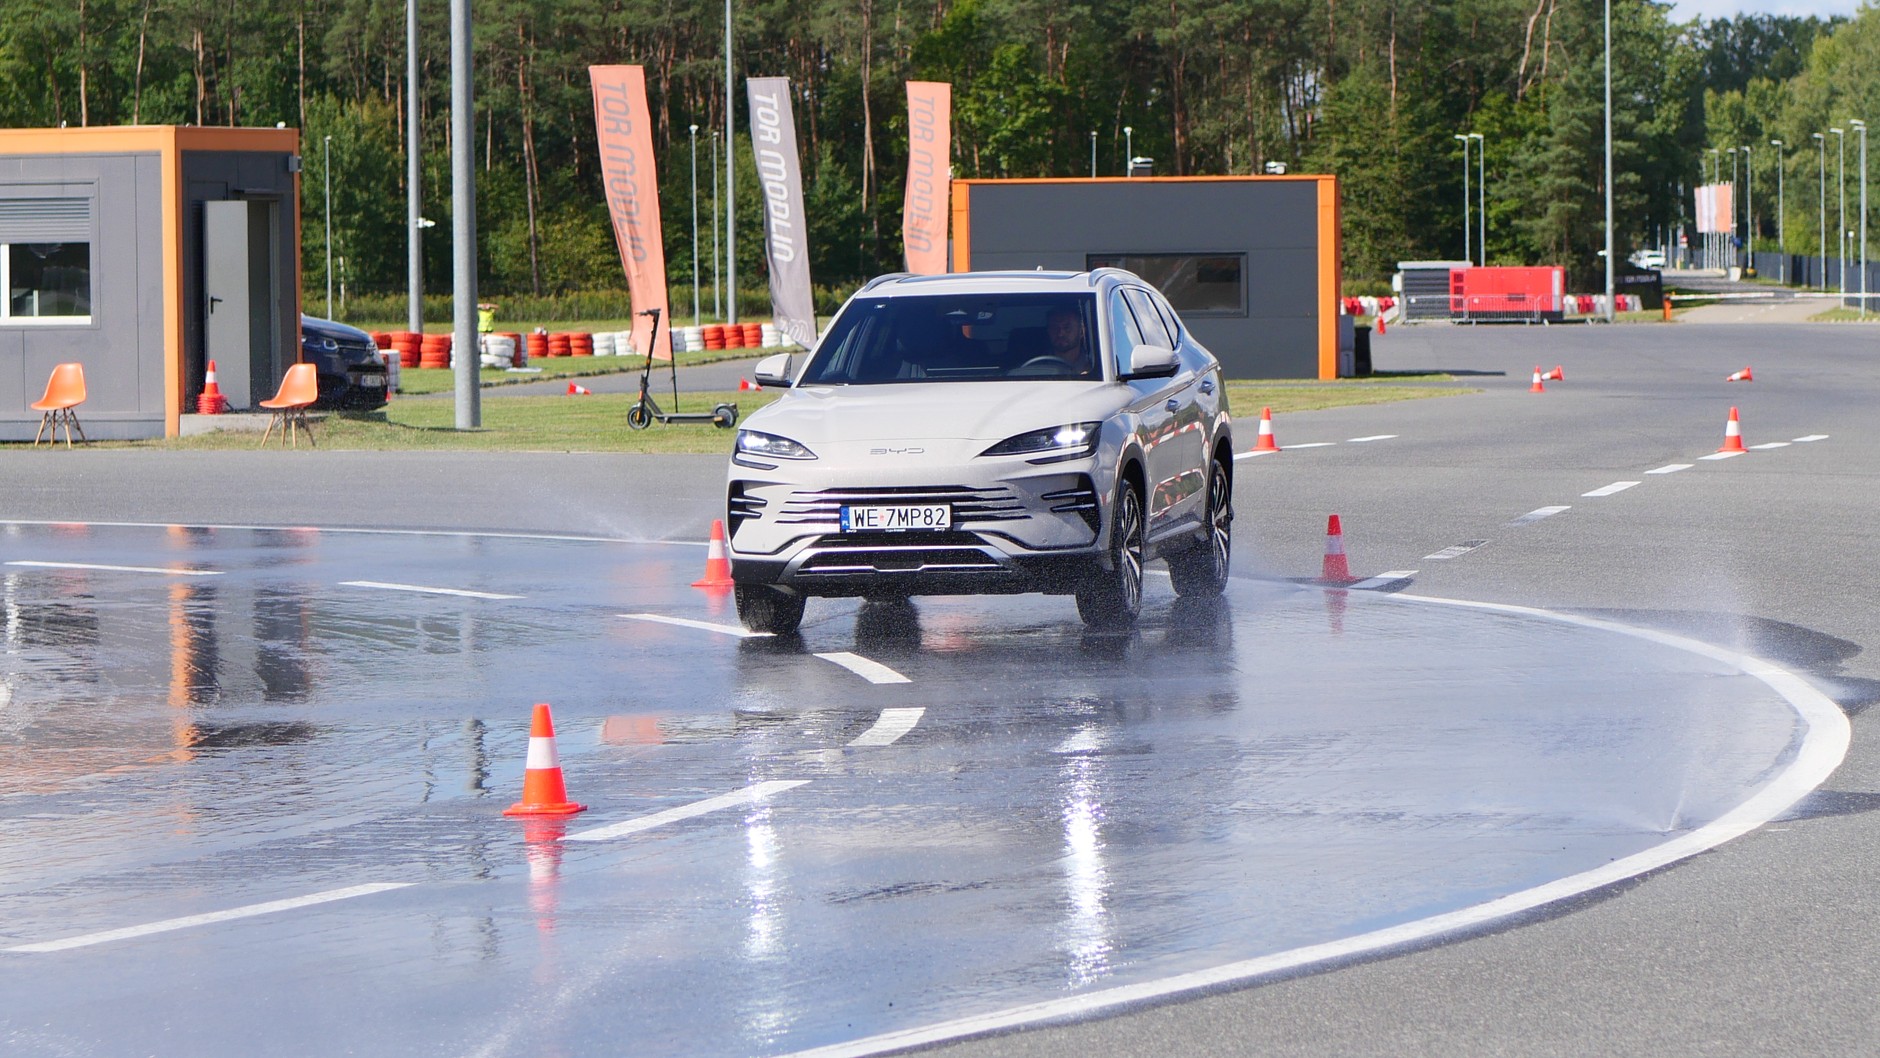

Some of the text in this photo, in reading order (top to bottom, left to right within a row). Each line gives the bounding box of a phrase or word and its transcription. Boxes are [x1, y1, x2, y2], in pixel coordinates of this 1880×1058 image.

[600, 82, 647, 263] TOR MODLIN
[754, 93, 795, 262] TOR MODLIN
[908, 97, 934, 253] TOR MODLIN
[854, 508, 878, 527] WE
[886, 507, 946, 526] 7MP82
